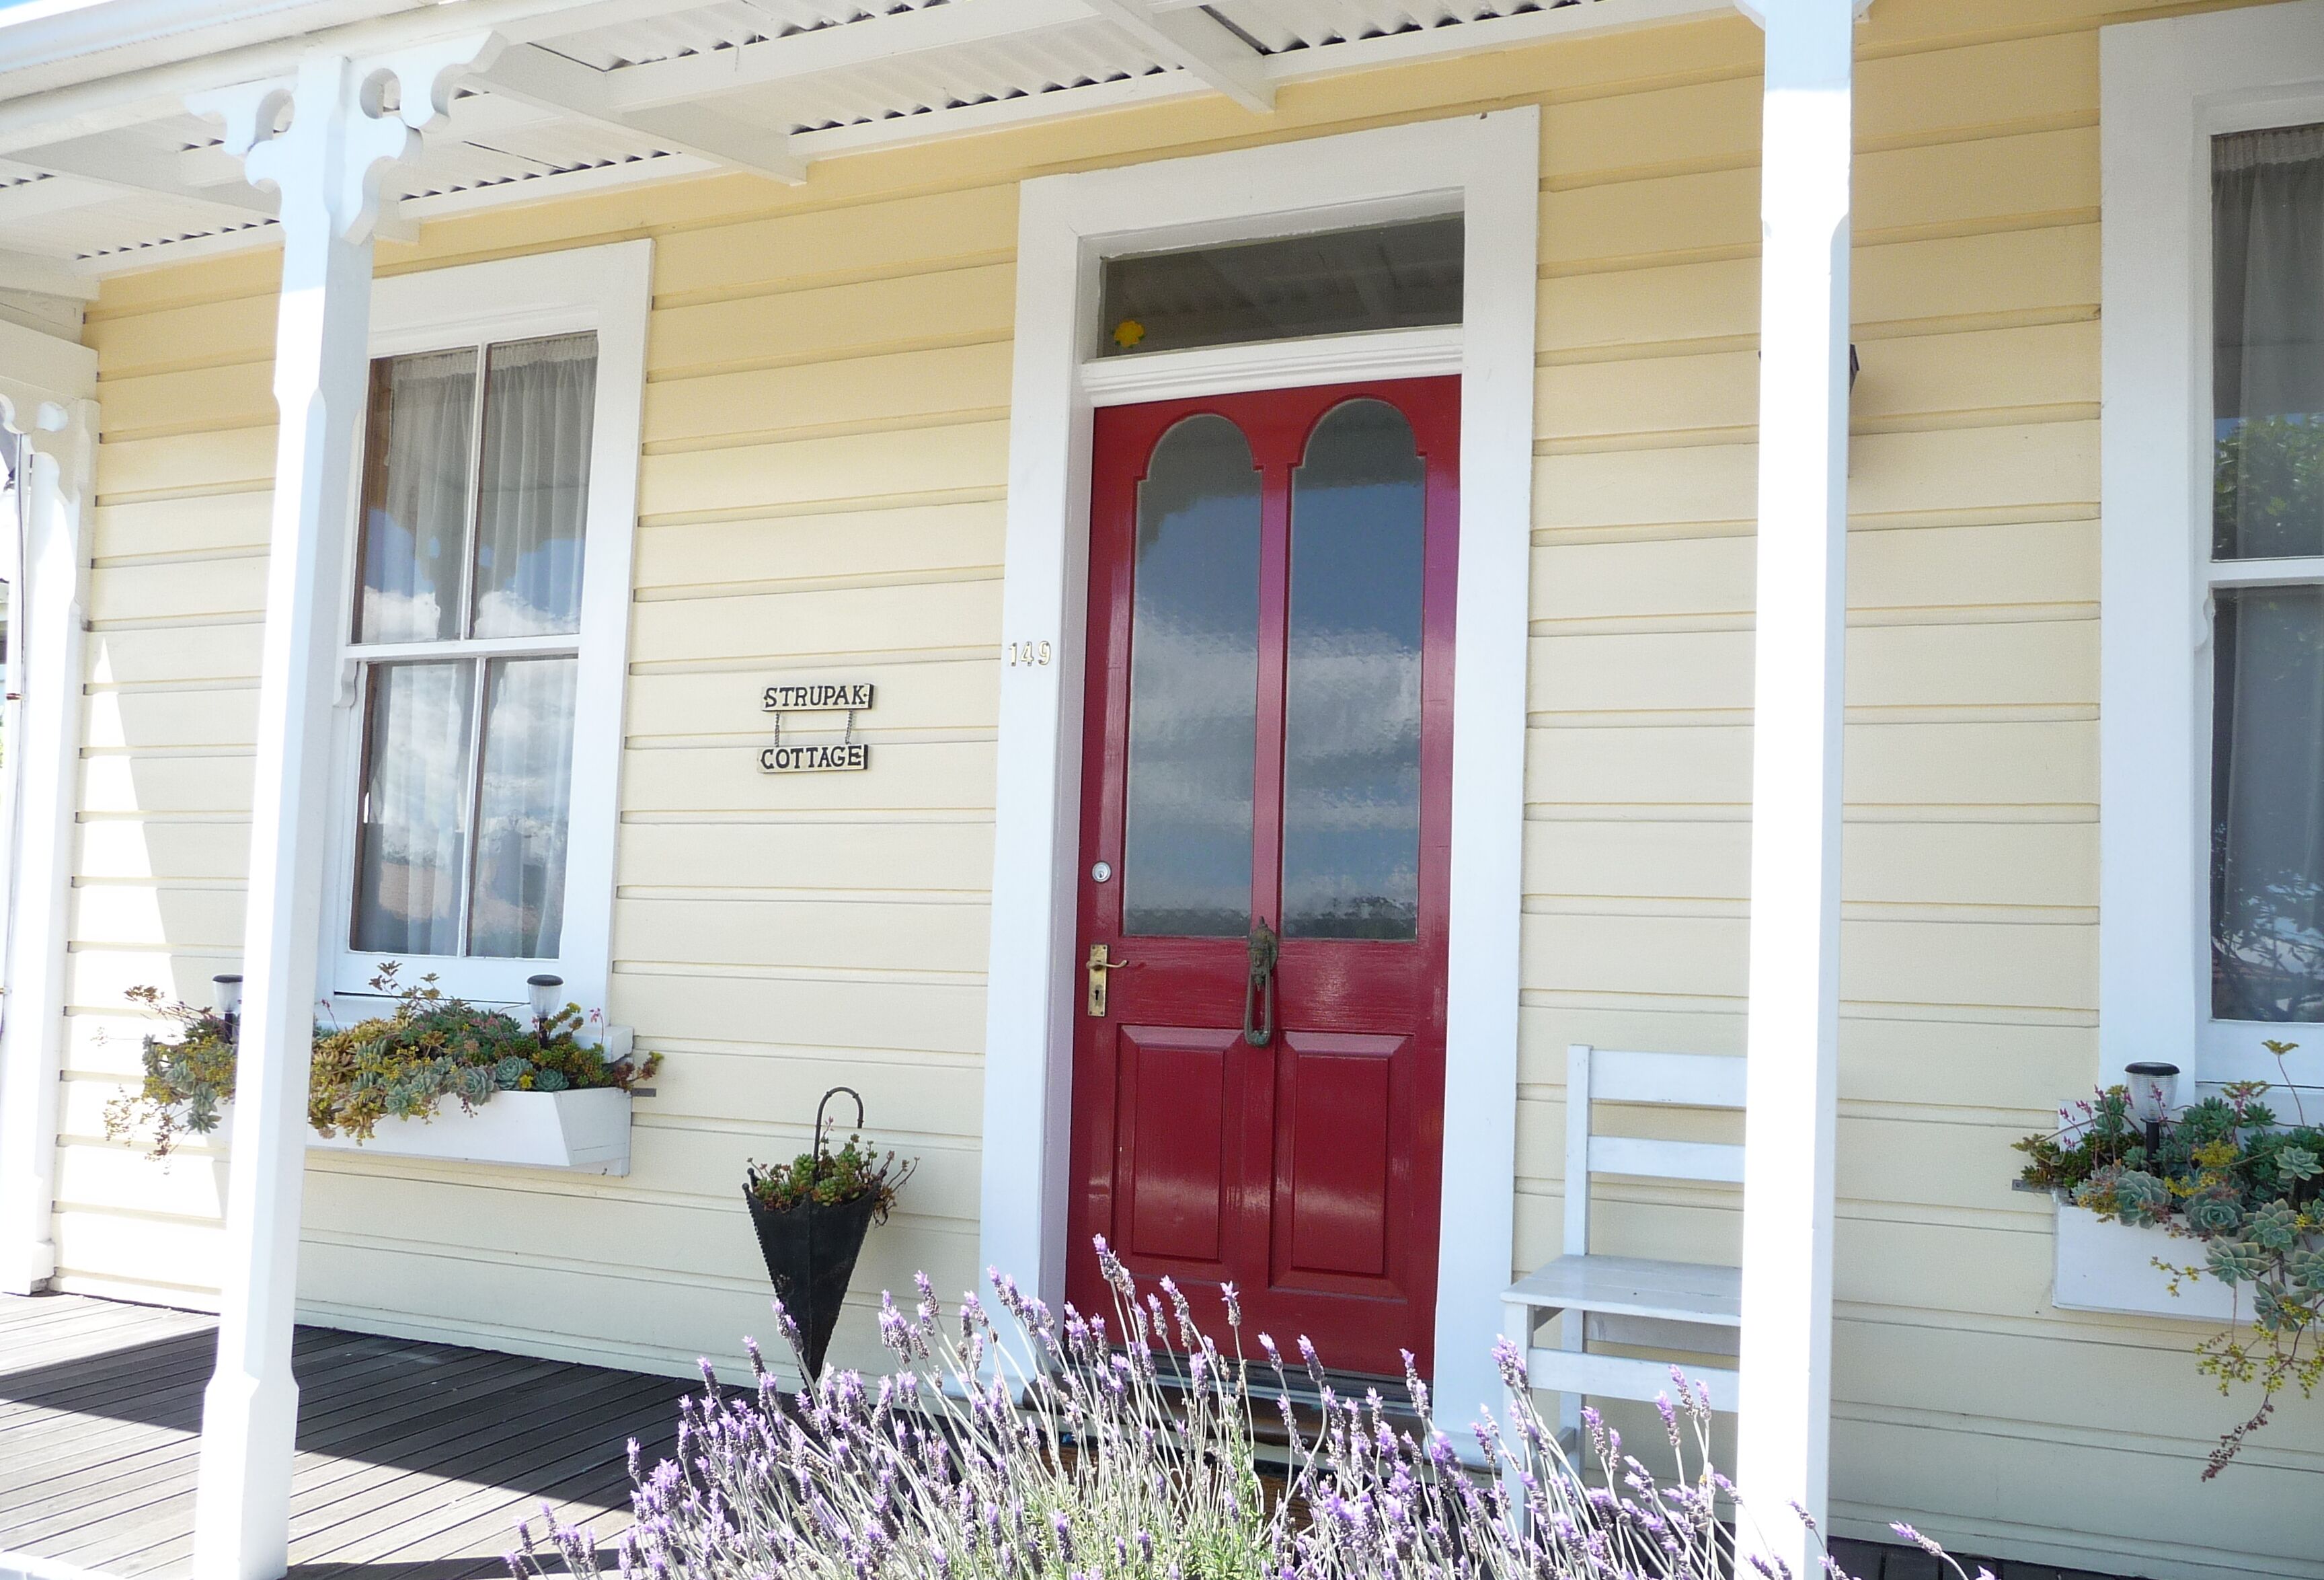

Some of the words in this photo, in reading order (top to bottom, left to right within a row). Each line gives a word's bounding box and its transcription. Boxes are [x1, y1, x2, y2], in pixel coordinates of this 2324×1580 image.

[1009, 640, 1051, 667] 149
[765, 685, 865, 708] STRUPAK
[761, 745, 861, 769] COTTAGE
